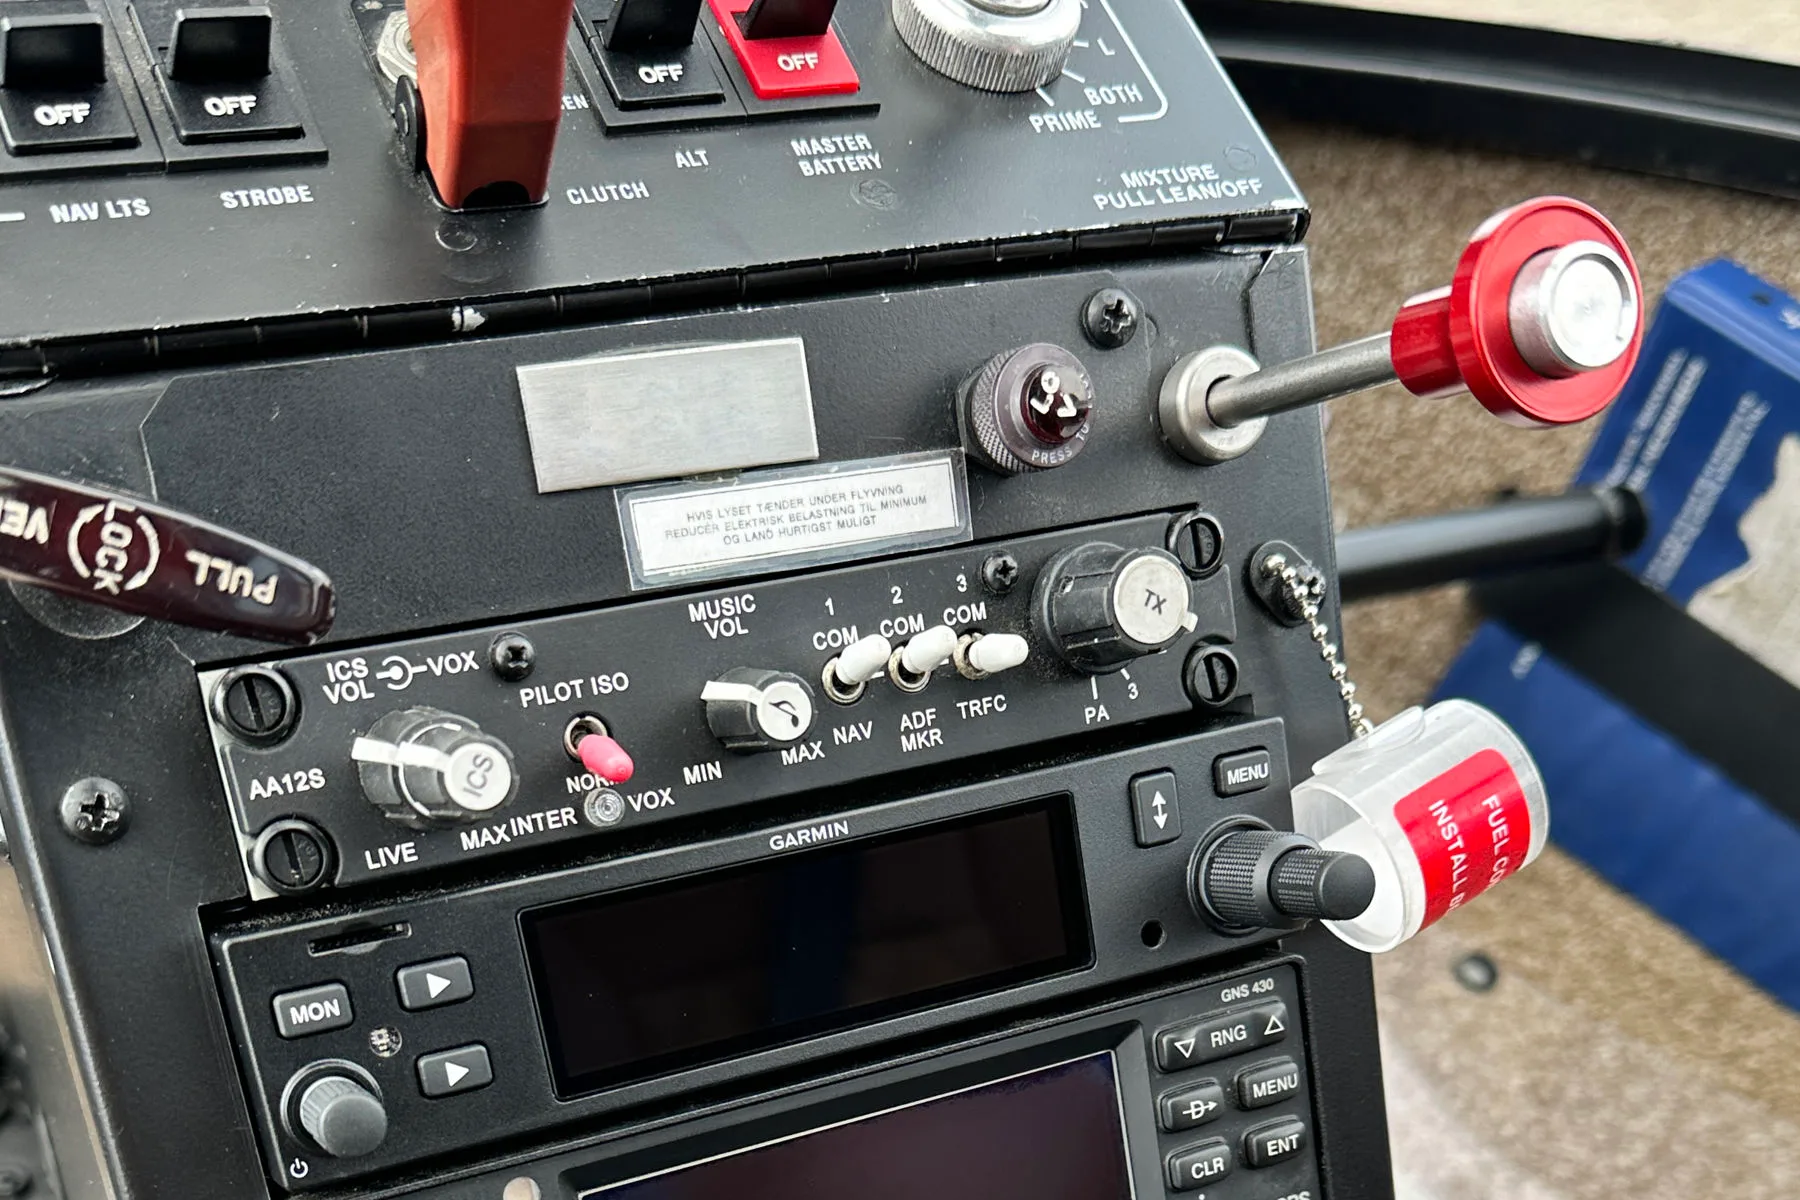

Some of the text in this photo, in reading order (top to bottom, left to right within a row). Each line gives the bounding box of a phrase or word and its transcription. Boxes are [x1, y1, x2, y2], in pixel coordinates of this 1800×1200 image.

[1097, 38, 1115, 55] L
[638, 65, 683, 84] OFF
[777, 53, 819, 72] OFF
[204, 96, 257, 117] OFF
[561, 93, 589, 110] EN
[1084, 83, 1143, 106] BOTH
[34, 104, 90, 127] OFF
[1029, 113, 1101, 133] PRIME
[790, 134, 872, 157] MASTER
[675, 150, 709, 168] ALT
[799, 152, 882, 177] BATTERY
[1120, 164, 1219, 189] MIXTURE
[220, 185, 314, 209] STROBE
[566, 182, 650, 206] CLUTCH
[1093, 178, 1262, 211] PULL LEAN/OFF
[50, 199, 151, 223] NAV LTS
[1031, 447, 1074, 464] PRESS
[687, 484, 904, 522] HVIS LYSET TÆNDER UNDER FLYVNING
[0, 497, 49, 544] VE
[664, 495, 927, 540] REDUCER ELEKTRISK BELASTNING TIL MINIMUM
[723, 534, 740, 546] OG
[779, 521, 833, 538] HURTIGST
[837, 515, 877, 530] MULIGT
[93, 500, 137, 595] LOCK
[185, 550, 278, 605] PULL
[956, 574, 967, 592] 3
[824, 597, 834, 616] 1
[891, 586, 903, 604] 2
[1144, 589, 1167, 615] TX
[688, 594, 757, 624] MUSIC
[943, 602, 987, 626] COM
[704, 619, 749, 641] VOL
[813, 625, 859, 650] COM
[880, 613, 925, 638] COM
[327, 650, 480, 683] ICS VOX
[322, 680, 375, 705] VOL
[519, 671, 630, 709] PILOT ISO
[1128, 683, 1139, 700] 3
[901, 708, 937, 732] ADF
[957, 695, 1007, 720] TRFC
[1084, 705, 1110, 725] PA
[833, 721, 873, 745] NAV
[901, 728, 944, 752] MKR
[781, 741, 826, 767] MAX
[249, 768, 326, 800] AA12S
[462, 752, 495, 798] ICS
[682, 762, 723, 786] MIN
[1227, 762, 1269, 786] MENU
[626, 787, 676, 813] VOX
[510, 807, 578, 837] INTER
[1482, 794, 1510, 856] FUEL
[460, 824, 511, 851] MAX
[769, 821, 849, 852] GARMIN
[1428, 799, 1469, 893] INSTALL
[365, 841, 419, 871] LIVE
[1221, 978, 1274, 1003] GNS 430
[290, 998, 341, 1025] MON
[1210, 1024, 1248, 1048] RNG
[1253, 1074, 1299, 1099] MENU
[1267, 1134, 1299, 1157] ENT
[1191, 1157, 1225, 1180] CLR
